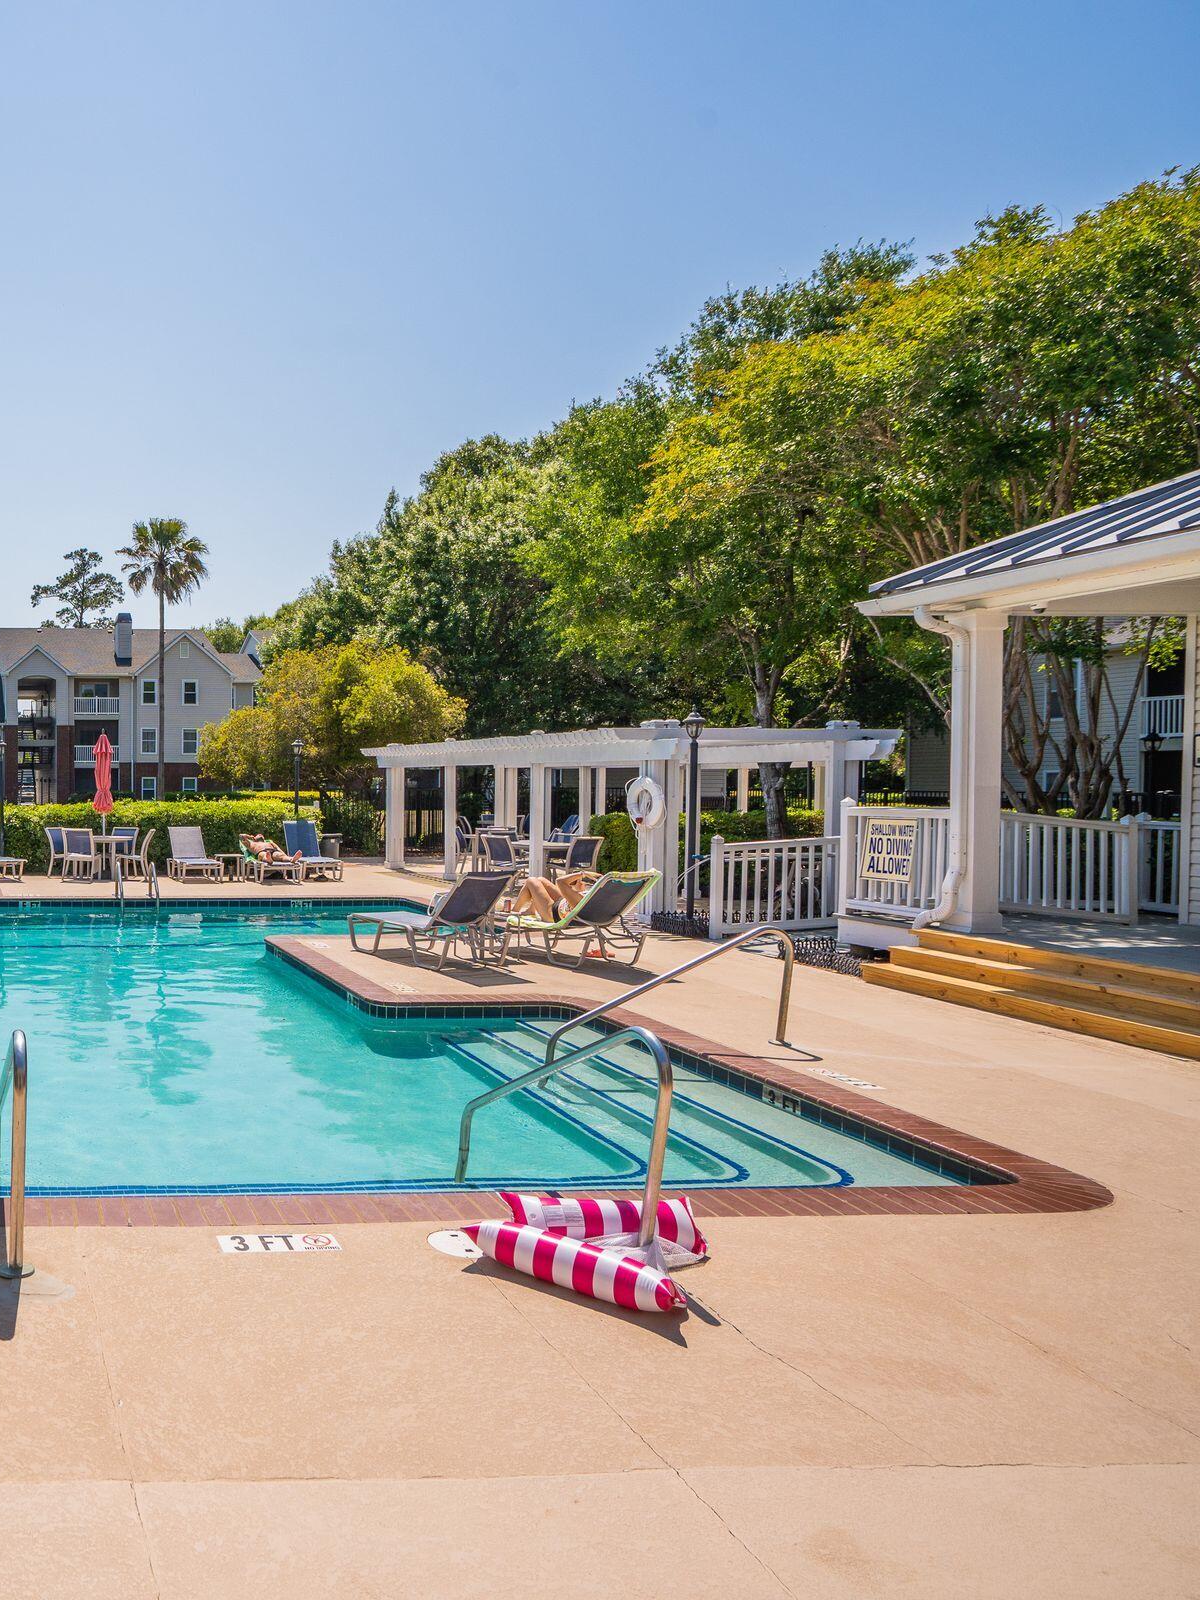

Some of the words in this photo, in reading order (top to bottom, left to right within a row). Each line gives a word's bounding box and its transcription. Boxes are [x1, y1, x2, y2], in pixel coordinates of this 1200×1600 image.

[869, 837, 883, 854] NO
[886, 838, 913, 856] DIVING
[782, 1093, 800, 1113] FT
[230, 1235, 250, 1251] 3
[257, 1235, 294, 1251] FT
